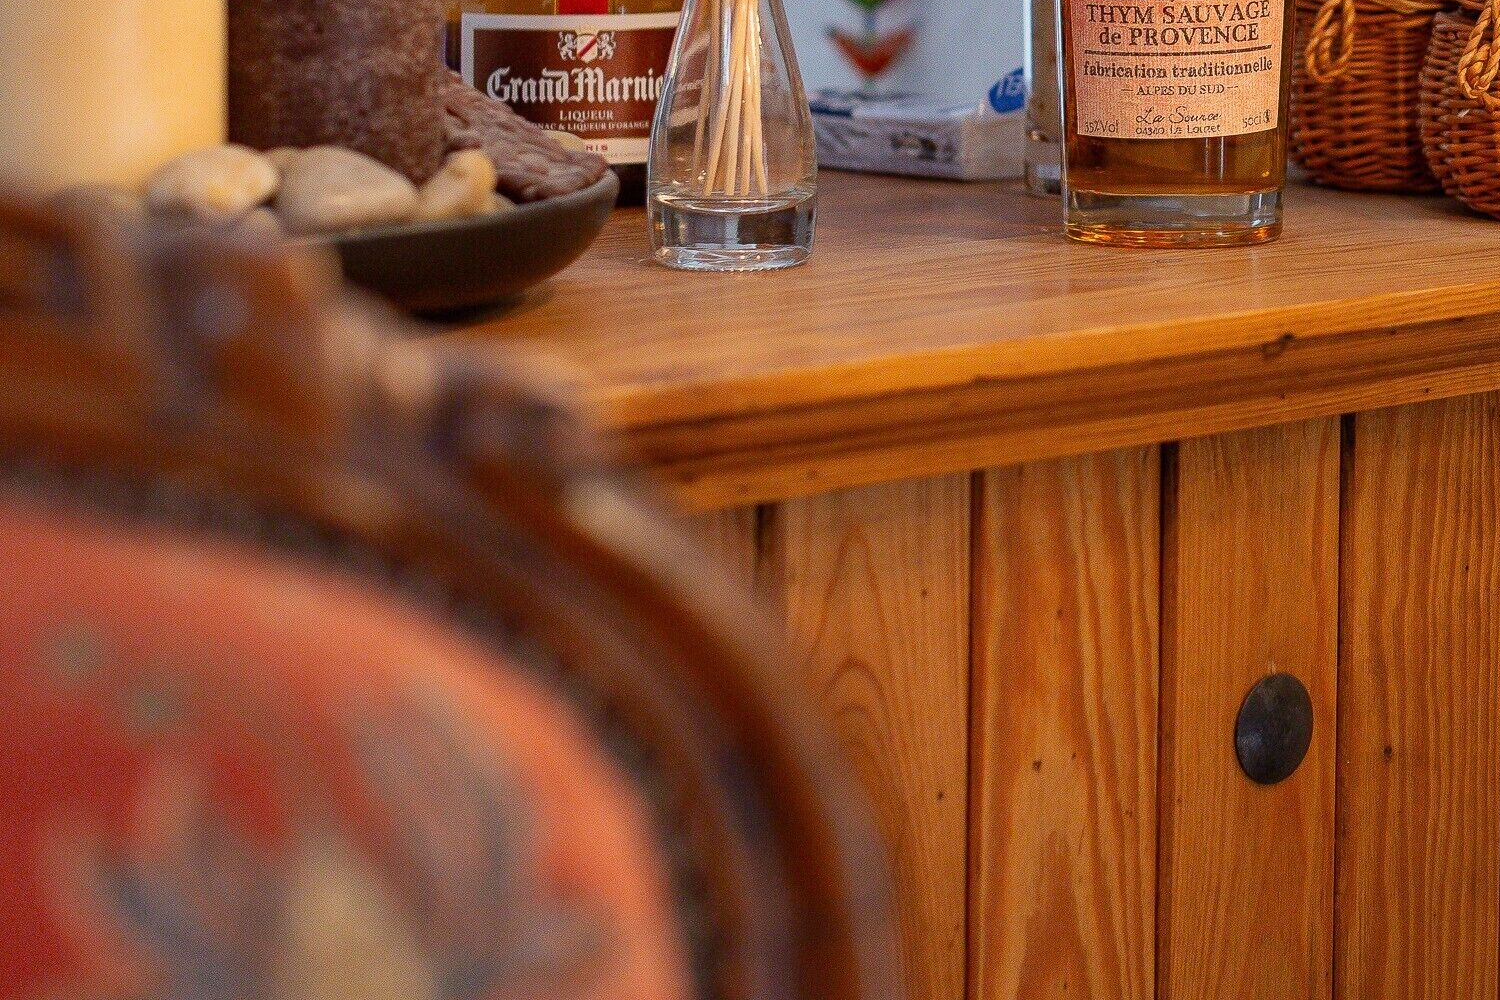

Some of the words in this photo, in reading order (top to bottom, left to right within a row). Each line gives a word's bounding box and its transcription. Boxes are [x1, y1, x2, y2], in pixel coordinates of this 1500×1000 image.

[1085, 3, 1155, 24] THYM
[1162, 0, 1271, 24] SAUVAGE
[1099, 27, 1122, 46] de
[1128, 22, 1259, 46] PROVENCE
[1083, 60, 1168, 78] fabrication
[1172, 55, 1273, 78] traditionnelle
[486, 66, 571, 103] Grand
[570, 66, 664, 103] Marnie
[1136, 85, 1175, 96] ALPES
[1178, 85, 1197, 96] DU
[1199, 84, 1225, 95] SUD
[559, 109, 614, 122] LIQUEUR
[1135, 106, 1165, 125] La
[1168, 105, 1221, 125] Source
[567, 121, 607, 132] LIQUEUR
